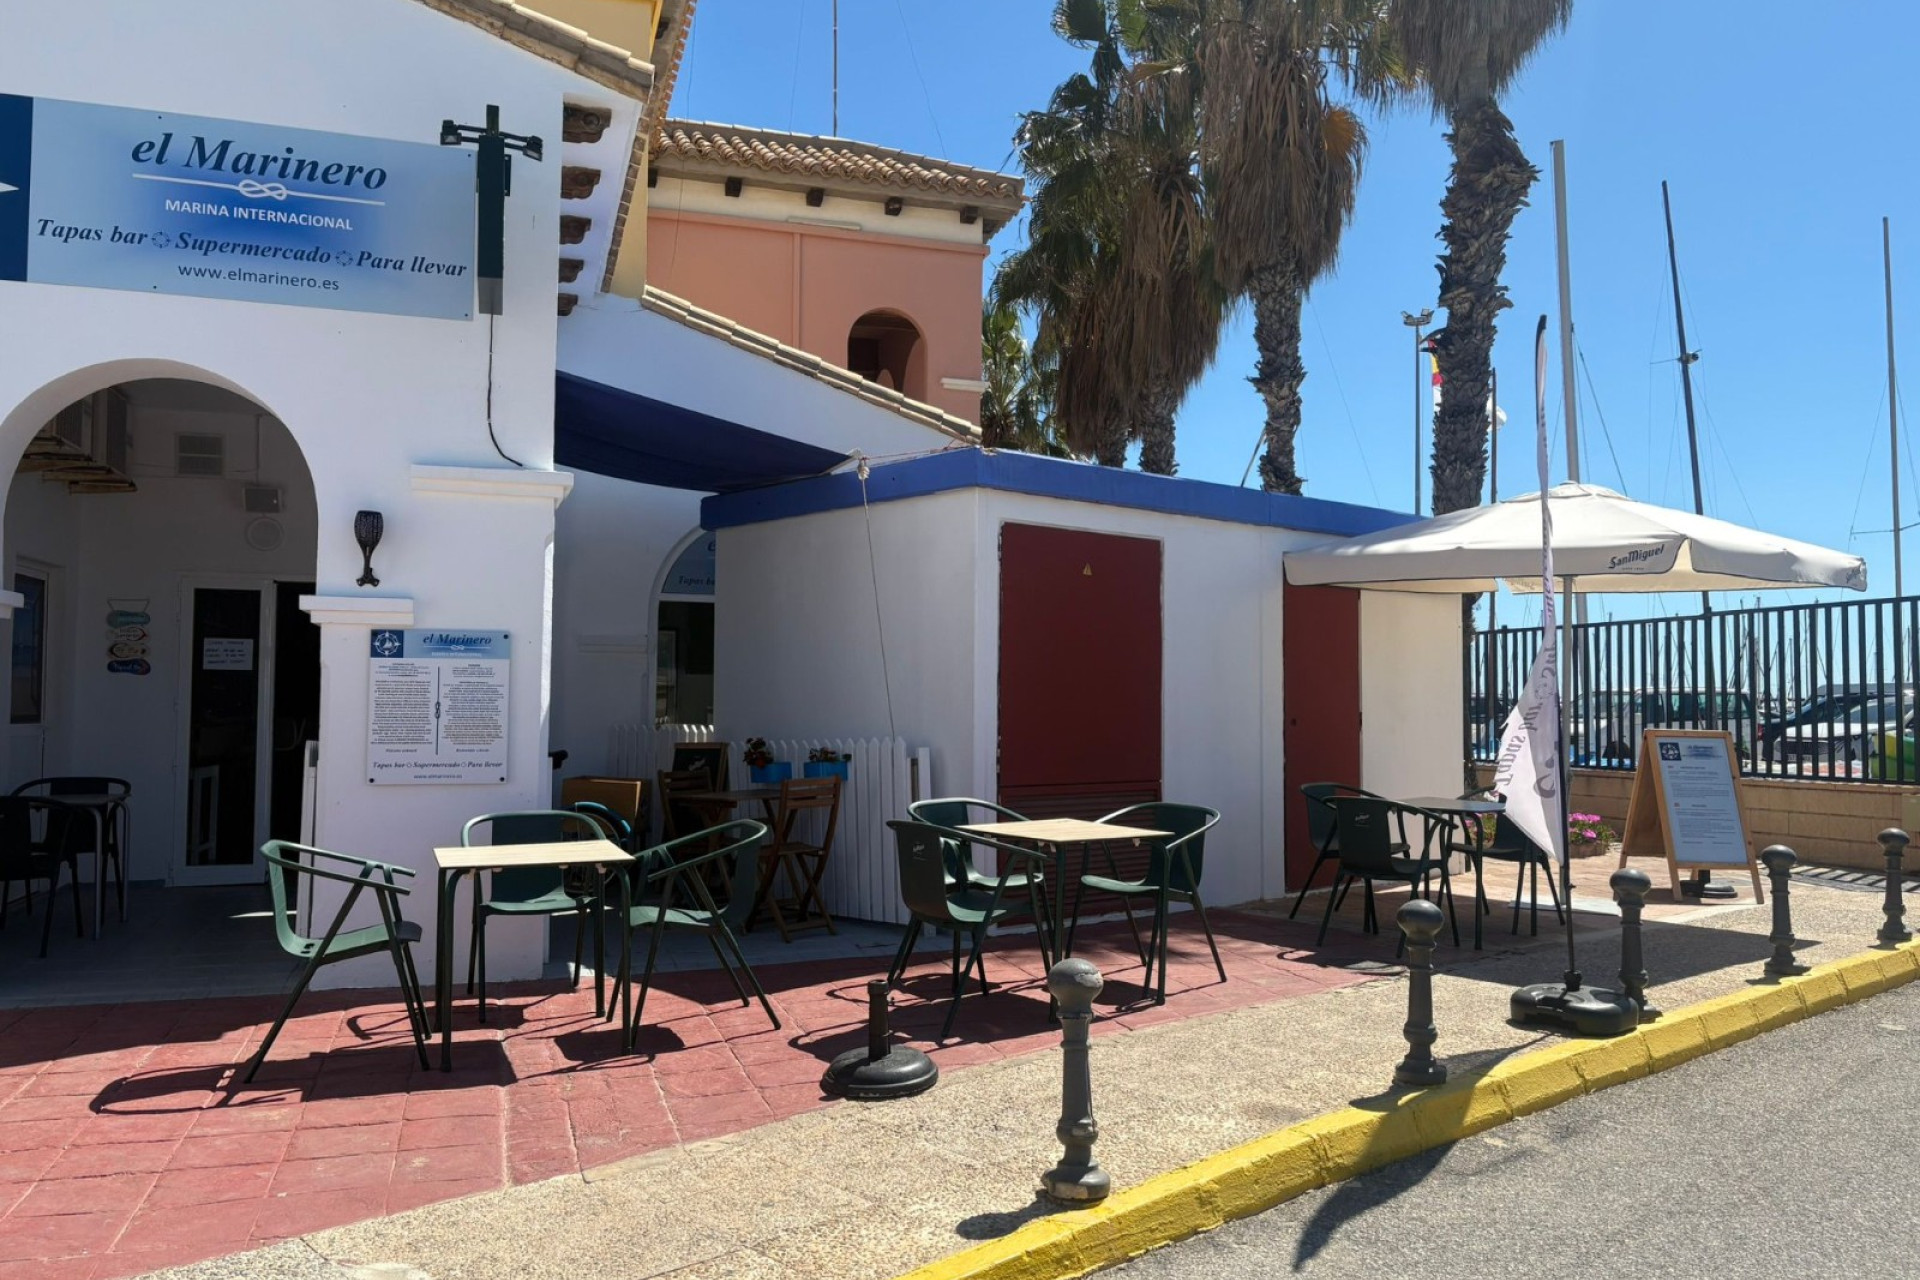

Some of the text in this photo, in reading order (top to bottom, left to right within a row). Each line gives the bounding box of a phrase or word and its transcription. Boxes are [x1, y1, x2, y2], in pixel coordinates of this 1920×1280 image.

[130, 132, 388, 190] el Marinero
[165, 198, 354, 231] MARINA INTERNACIONAL
[36, 218, 468, 277] Tapas bar Supermercado Para llevar
[178, 264, 340, 292] www.elmarinero.es
[423, 633, 492, 646] el Marinero
